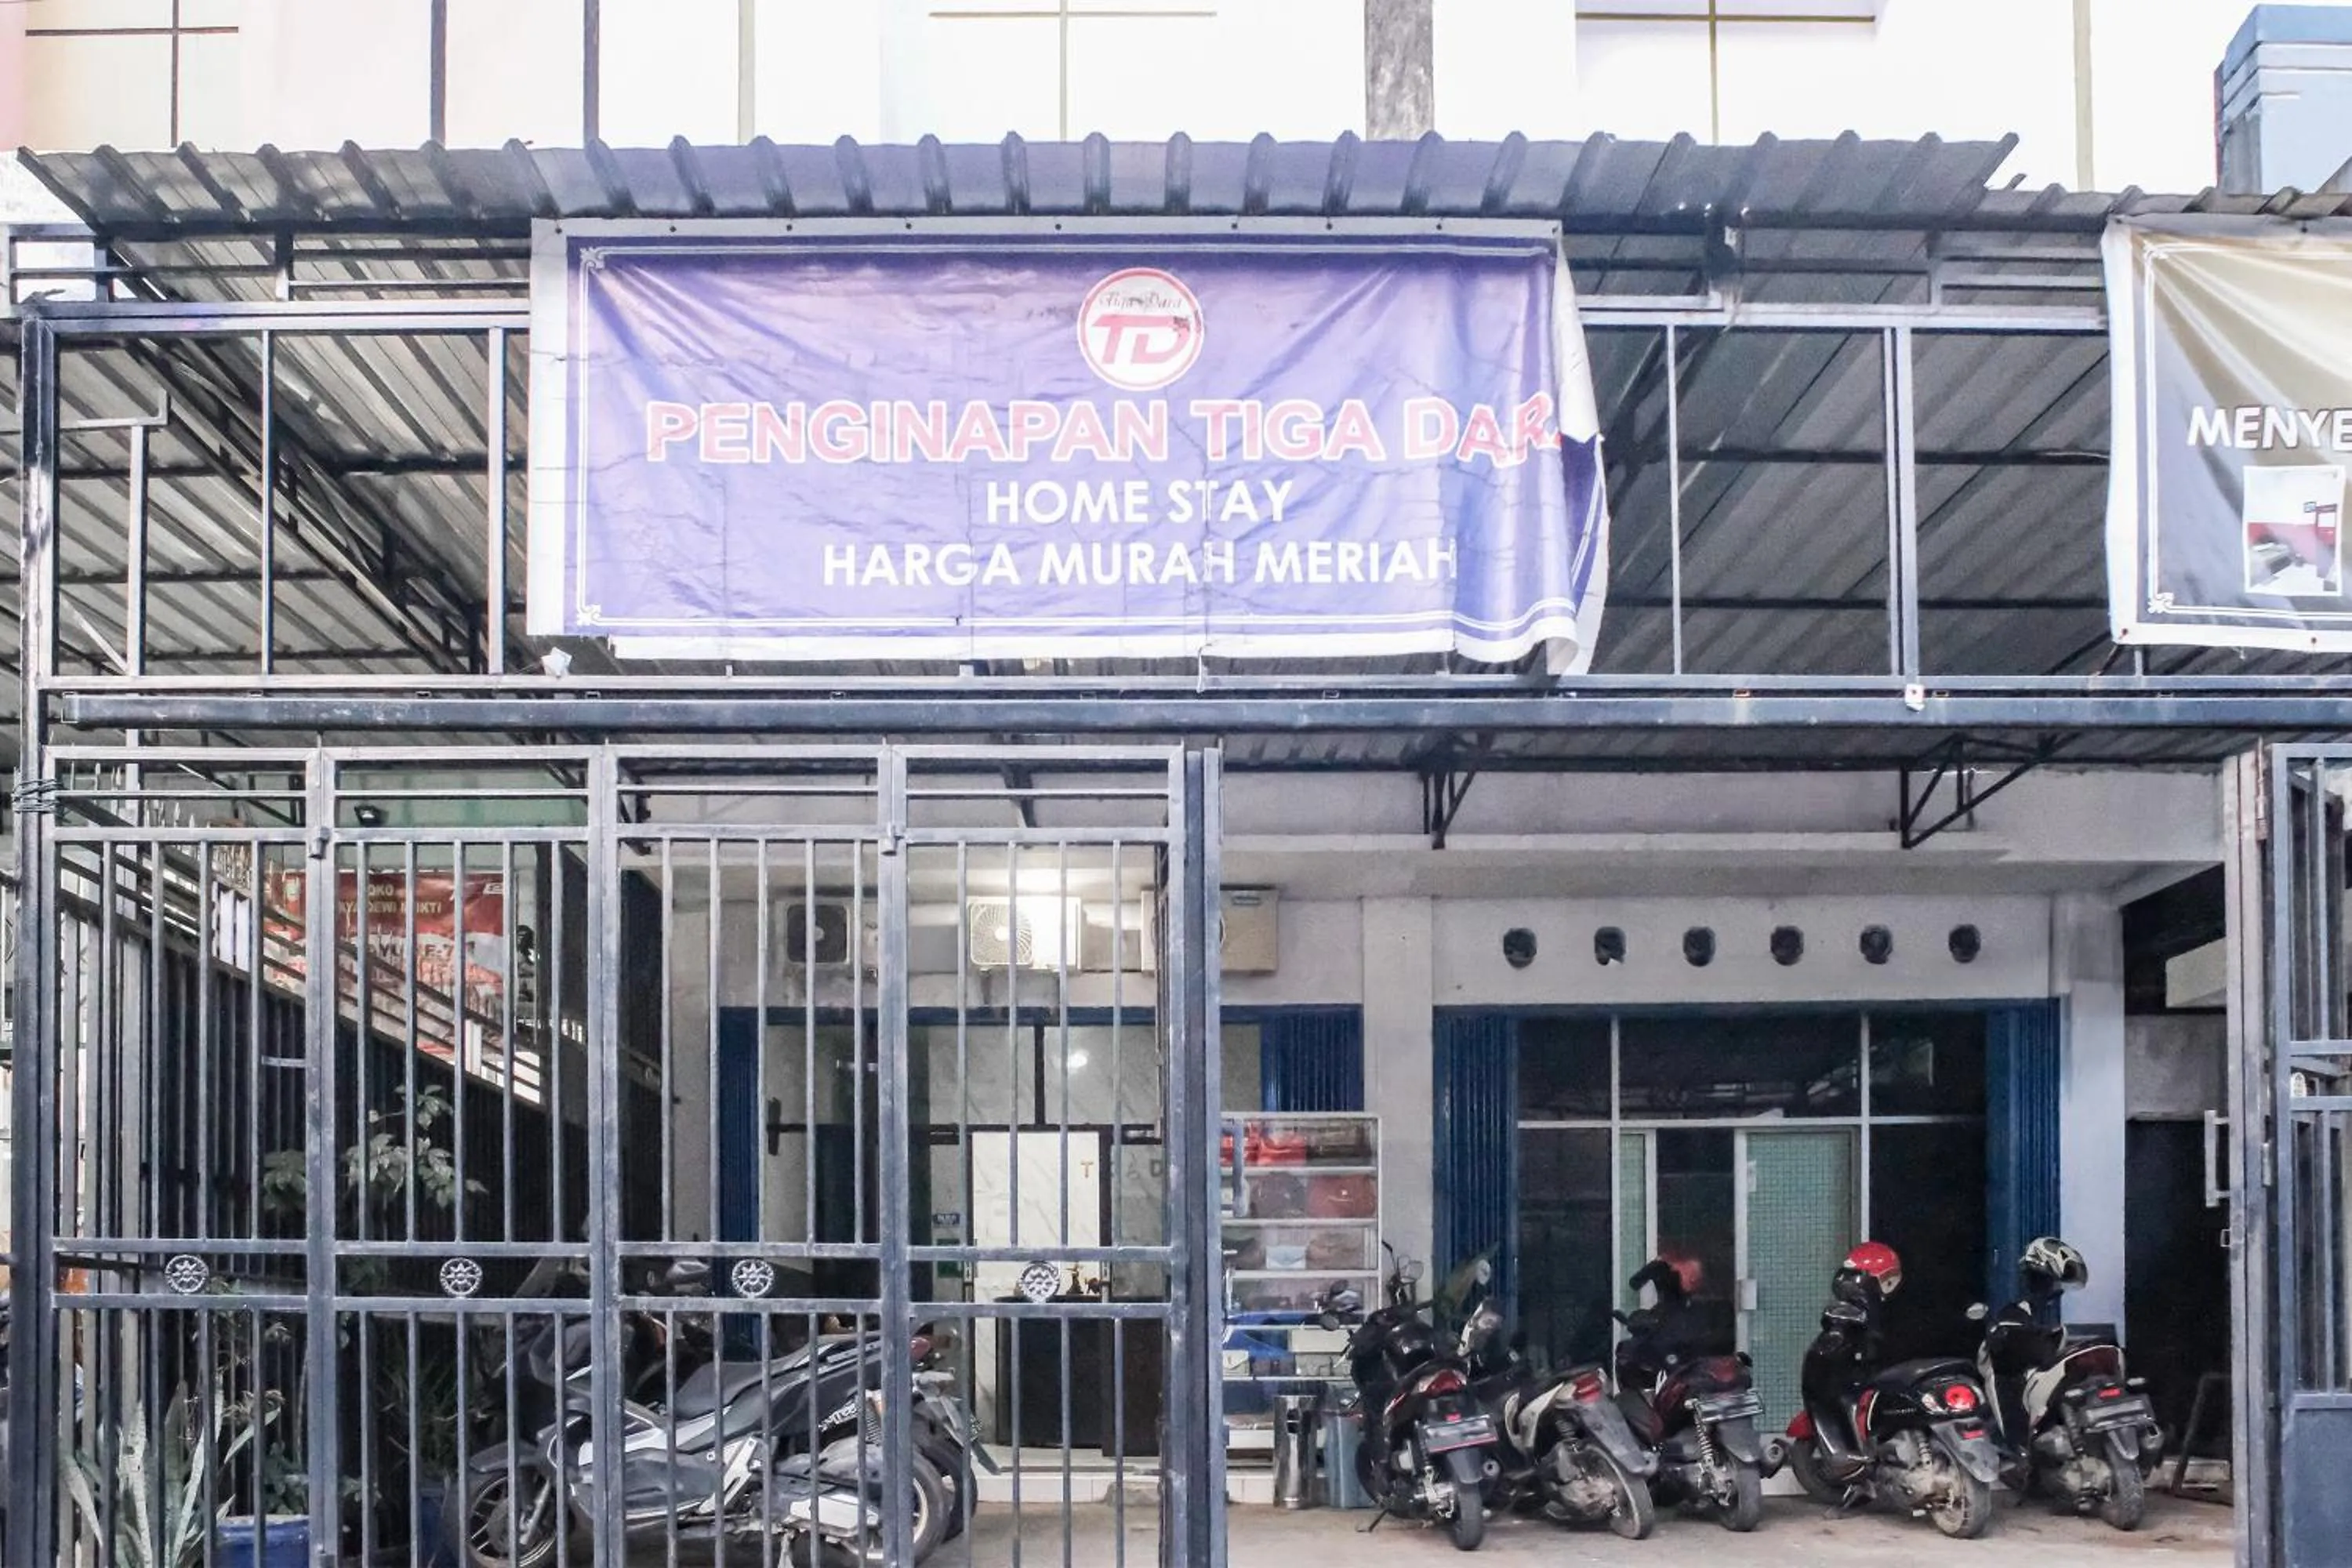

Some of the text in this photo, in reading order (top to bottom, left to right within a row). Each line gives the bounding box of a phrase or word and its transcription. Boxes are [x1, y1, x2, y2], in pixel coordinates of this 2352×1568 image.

[647, 391, 1562, 468] PENGINAPAN TIGA DAR
[986, 480, 1293, 524] HOME STAY
[823, 537, 1457, 586] HARGA MURAH MERIAH
[366, 884, 394, 896] OKO
